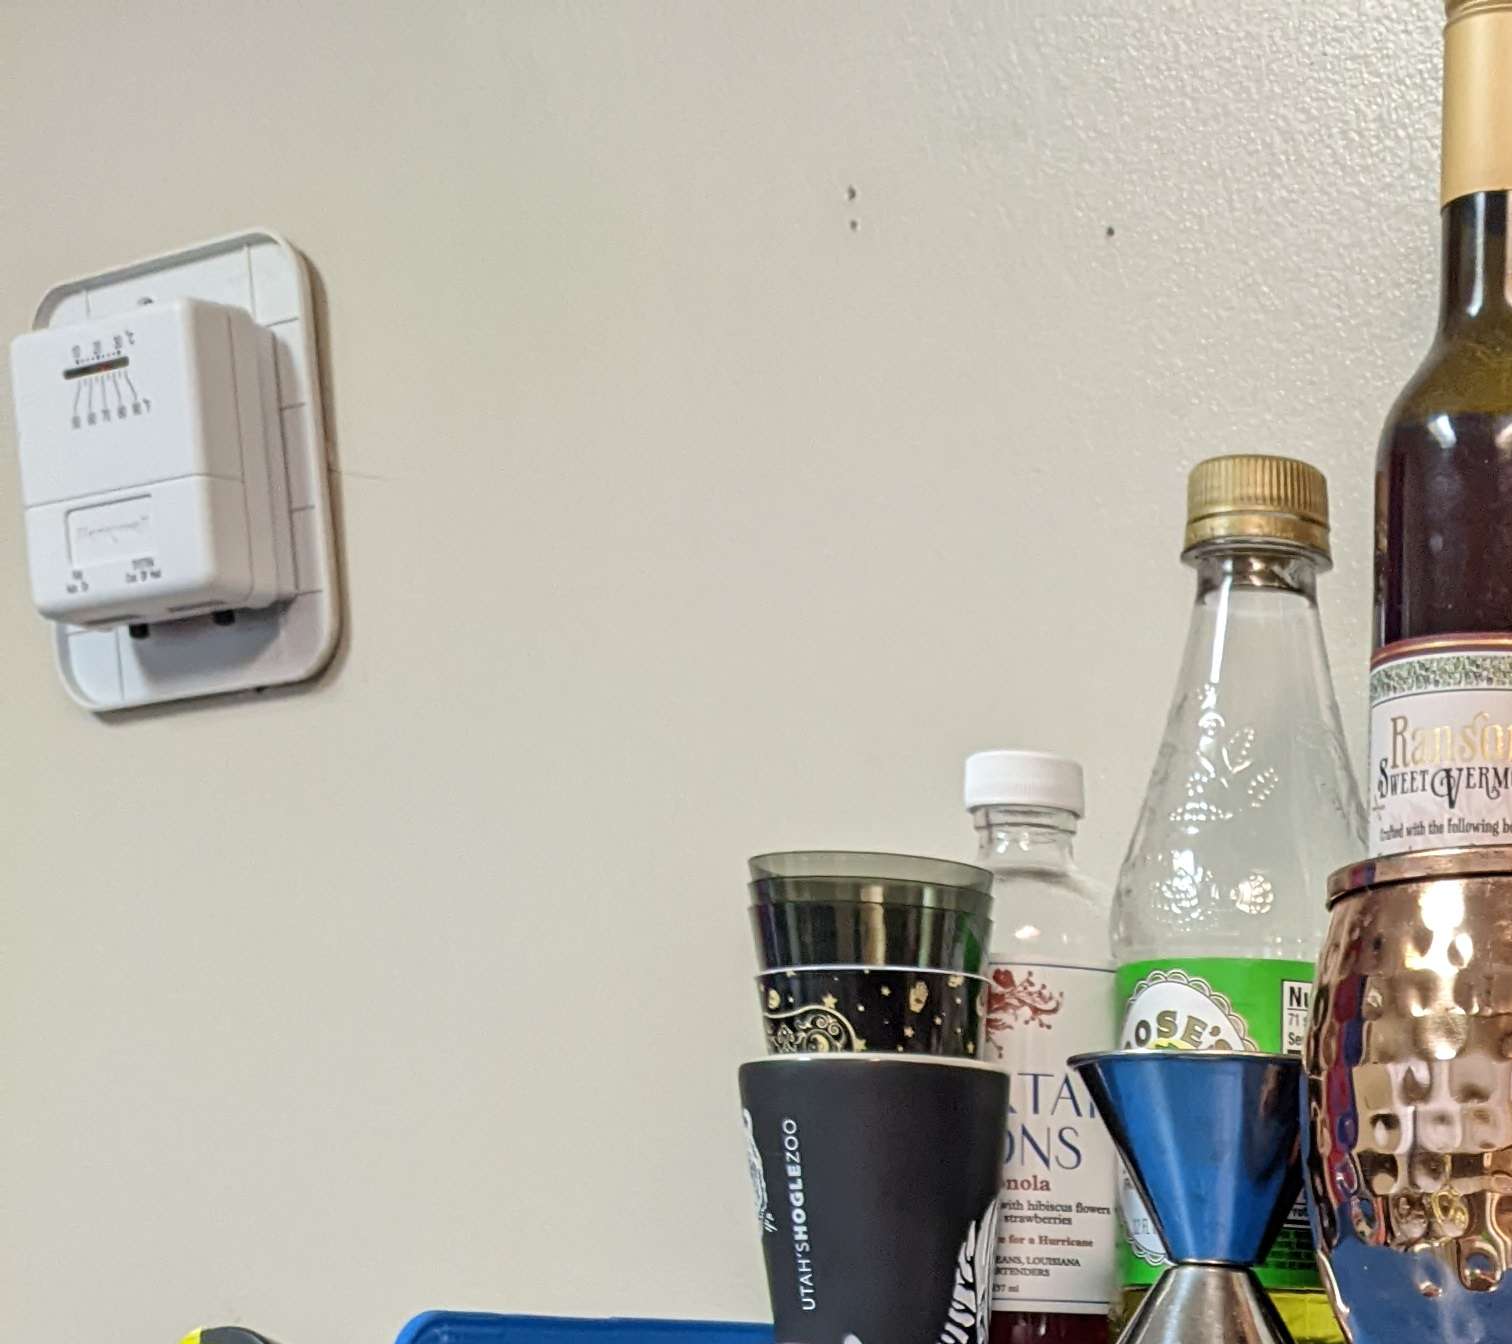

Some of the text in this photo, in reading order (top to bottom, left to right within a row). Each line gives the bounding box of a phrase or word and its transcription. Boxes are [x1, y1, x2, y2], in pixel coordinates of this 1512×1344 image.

[1406, 820, 1426, 836] with
[1428, 818, 1445, 835] the
[1447, 817, 1499, 837] following
[1027, 1200, 1073, 1213] hibiscus
[1075, 1202, 1111, 1216] flowers
[1004, 1214, 1073, 1226] strawberries
[1008, 1234, 1026, 1245] for
[1038, 1235, 1094, 1248] Hurricane
[1027, 1256, 1081, 1267] LOUISIANA
